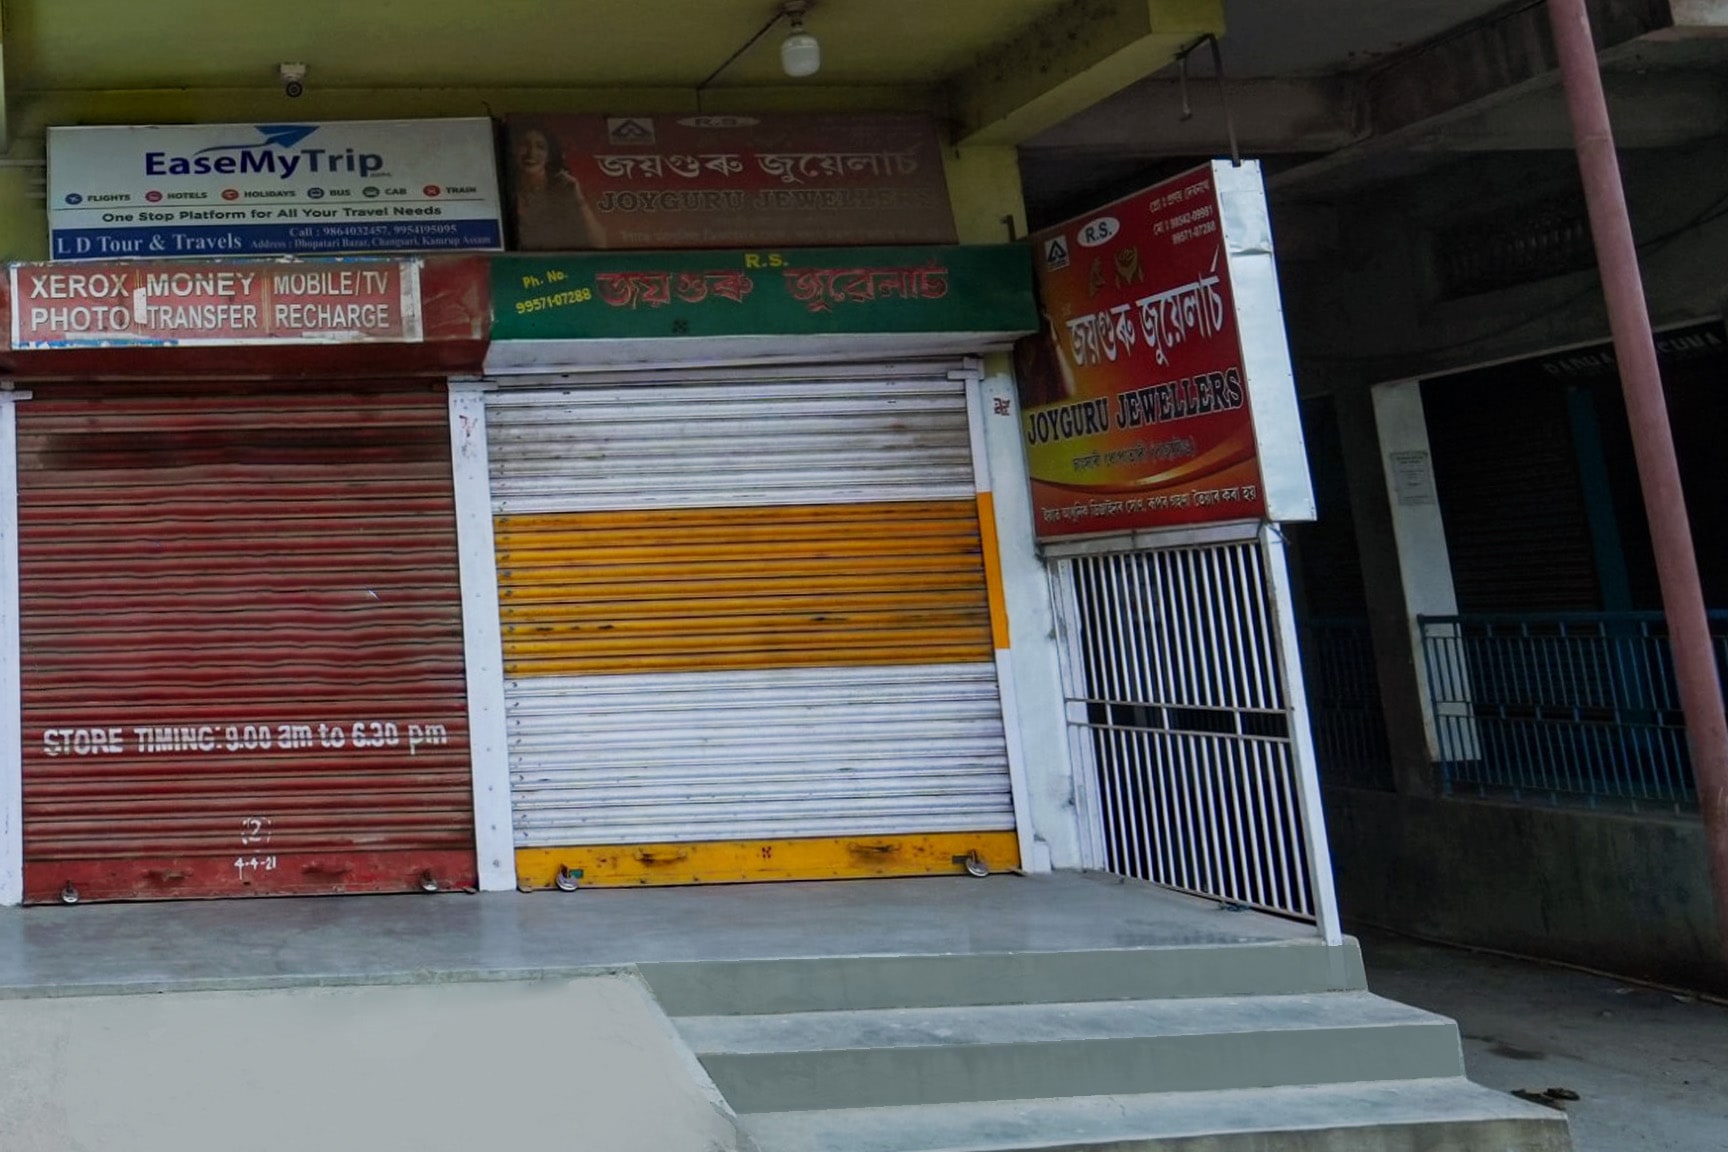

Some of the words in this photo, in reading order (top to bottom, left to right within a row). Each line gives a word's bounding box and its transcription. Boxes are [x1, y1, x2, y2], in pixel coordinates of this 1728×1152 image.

[145, 147, 384, 179] EaseMyTrip
[87, 194, 131, 202] FLIGHTS
[167, 192, 208, 200] HOTELS
[244, 189, 296, 198] HOLIDAYS
[330, 189, 351, 197] BUS
[385, 187, 407, 196] CAB
[446, 186, 477, 194] TRAIN
[597, 190, 743, 213] JOYGURU
[102, 213, 134, 223] One
[138, 211, 175, 222] Stop
[179, 208, 246, 221] Platform
[251, 207, 273, 219] for
[277, 208, 298, 218] All
[303, 208, 338, 218] Your
[343, 206, 388, 218] Travel
[393, 205, 442, 217] Needs
[57, 238, 72, 254] L
[77, 237, 90, 253] D
[97, 235, 143, 252] Tour
[149, 234, 165, 250] &
[172, 232, 242, 250] Travels
[289, 227, 313, 237] Call
[1086, 222, 1112, 243] R.S.
[745, 253, 789, 268] R.S.
[31, 274, 129, 299] XEROX
[146, 272, 255, 296] MONEY
[274, 272, 389, 294] MOBILE/TV
[523, 275, 544, 288] Ph.
[31, 305, 130, 331] PHOTO
[146, 305, 258, 329] TRANSFER
[276, 304, 389, 328] RECHARGE
[1027, 398, 1108, 444] JOYGURU
[1116, 367, 1242, 428] JEWELLERS
[44, 728, 123, 756] STORE
[134, 726, 223, 753] TIMING:
[225, 725, 272, 750] 9.00
[278, 724, 314, 748] am
[319, 723, 345, 749] to
[352, 722, 399, 748] 6.30
[408, 723, 448, 755] pm
